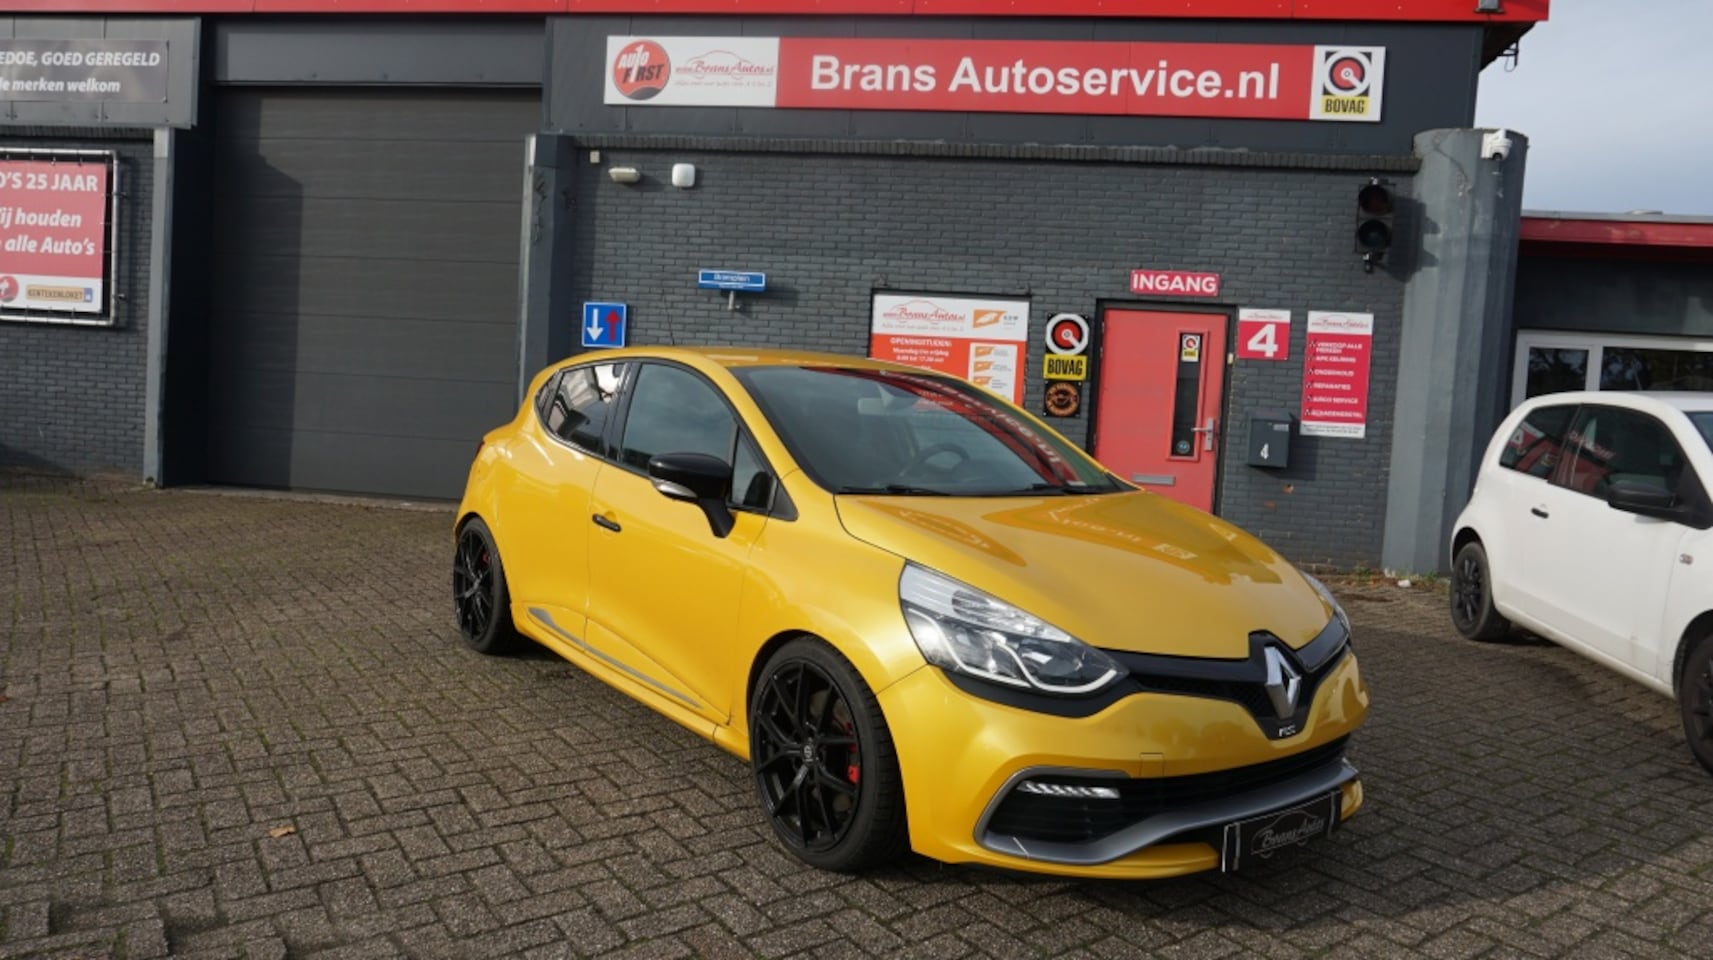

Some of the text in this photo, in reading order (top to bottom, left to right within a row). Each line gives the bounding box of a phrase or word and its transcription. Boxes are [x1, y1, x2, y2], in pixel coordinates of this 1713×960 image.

[41, 52, 83, 66] GOED
[85, 52, 160, 67] GEREGELD
[12, 77, 64, 92] merken
[67, 78, 121, 92] welkom
[810, 54, 1280, 99] Brans Autoservice.nl
[1325, 98, 1365, 114] BOVAG
[26, 173, 48, 190] 25
[51, 174, 99, 193] JAAR
[15, 207, 83, 228] houden
[5, 234, 96, 256] alle Auto's
[1133, 273, 1217, 293] INGANG
[1248, 323, 1278, 357] 4
[1047, 359, 1083, 376] BOVAG
[1260, 443, 1269, 459] 4
